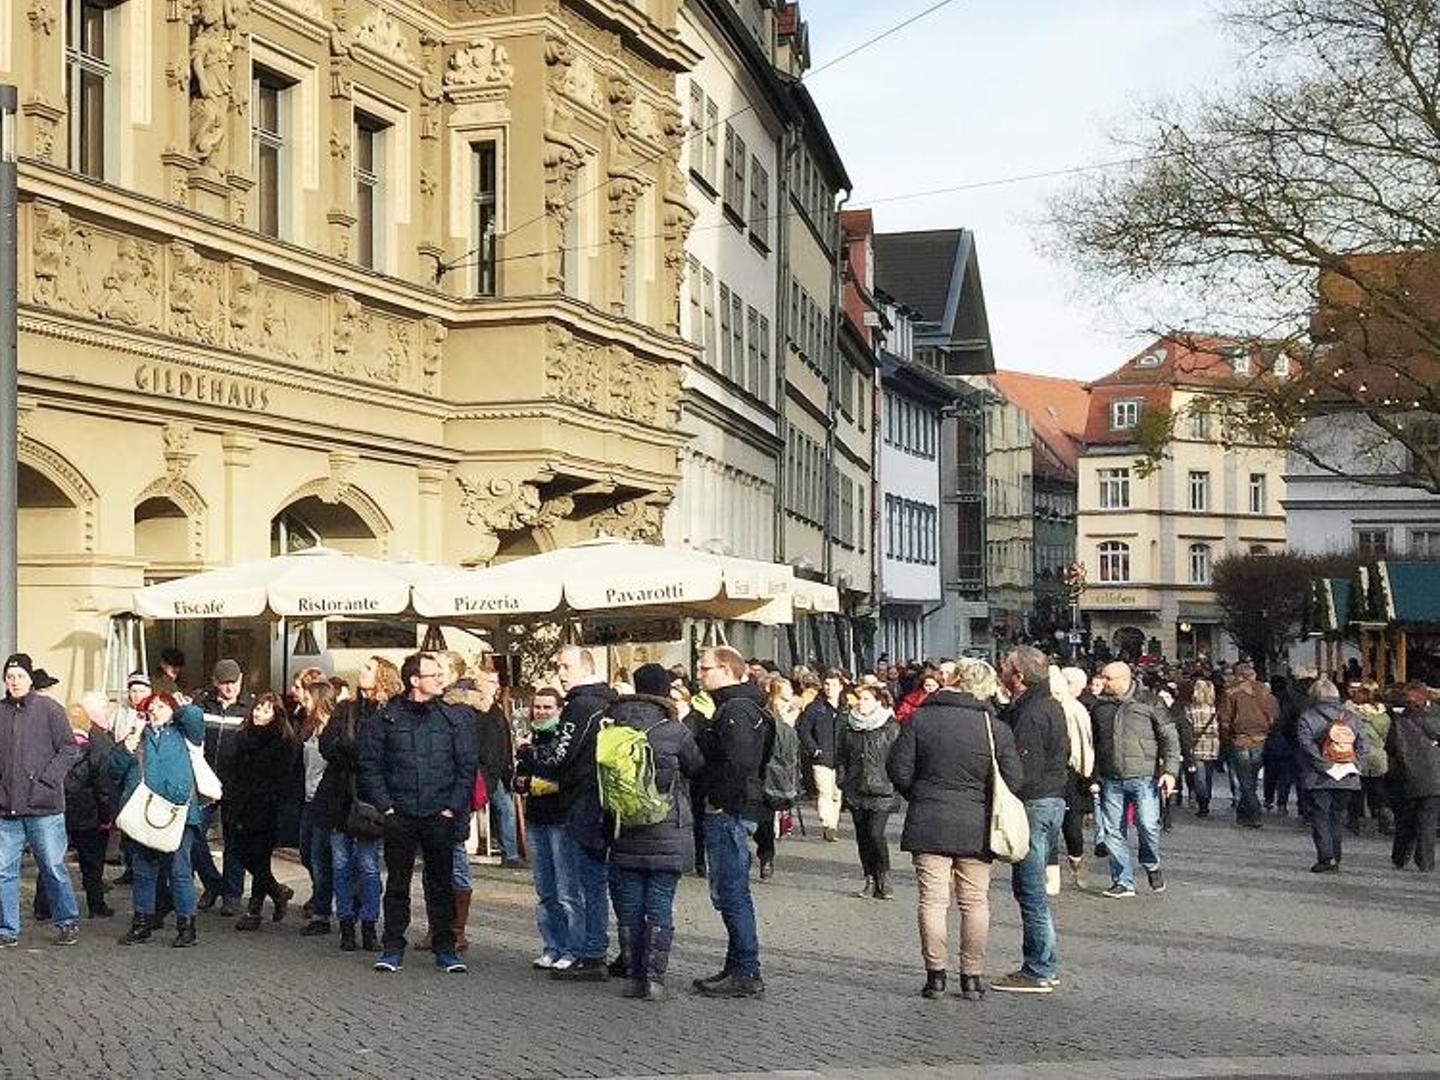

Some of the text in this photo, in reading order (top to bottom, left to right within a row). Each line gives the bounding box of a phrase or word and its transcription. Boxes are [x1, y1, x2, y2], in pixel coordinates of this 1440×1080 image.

[133, 363, 271, 411] GILDEHAUS
[605, 582, 684, 605] Pavarotti
[298, 597, 380, 613] Ristorante
[453, 595, 520, 613] Pizzeria
